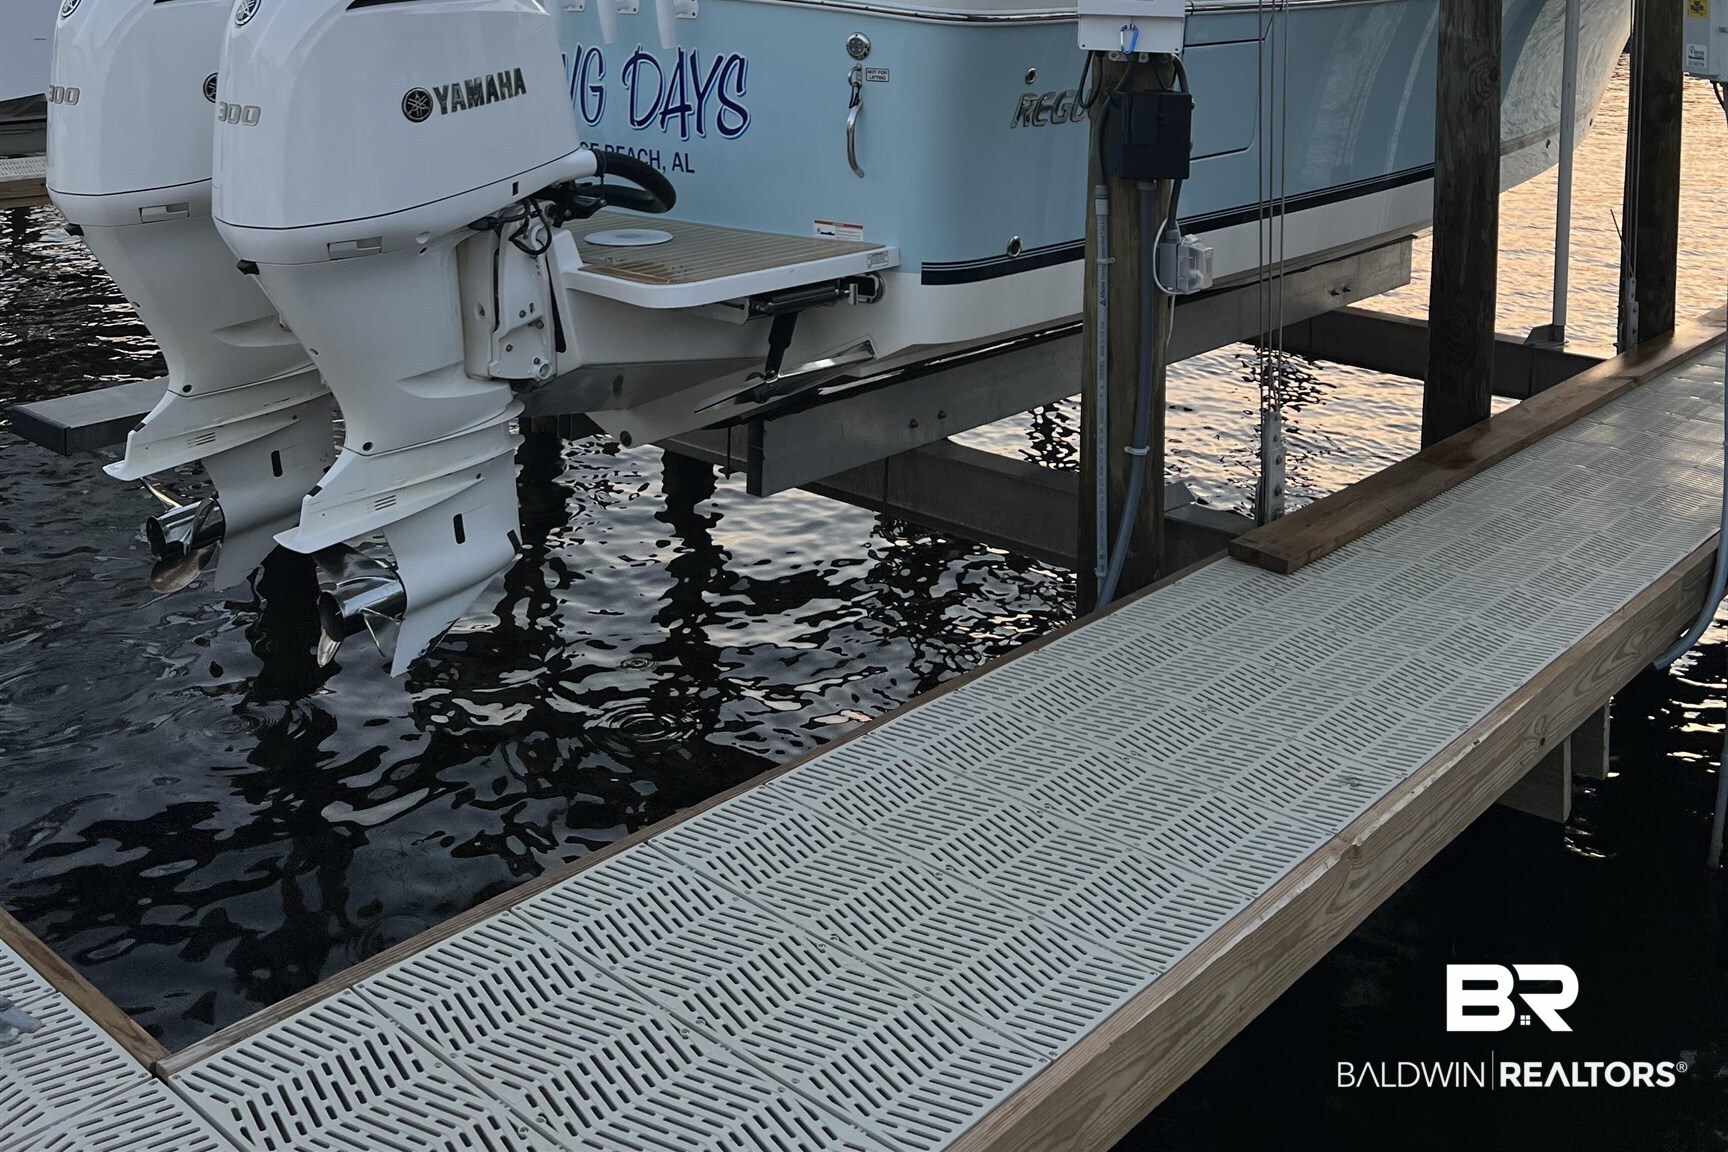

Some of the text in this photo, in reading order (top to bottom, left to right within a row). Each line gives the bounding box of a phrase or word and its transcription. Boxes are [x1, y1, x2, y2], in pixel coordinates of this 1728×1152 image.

[432, 67, 527, 116] YAMAHA
[621, 43, 751, 141] DAYS
[218, 101, 261, 126] 300
[672, 152, 695, 174] AL
